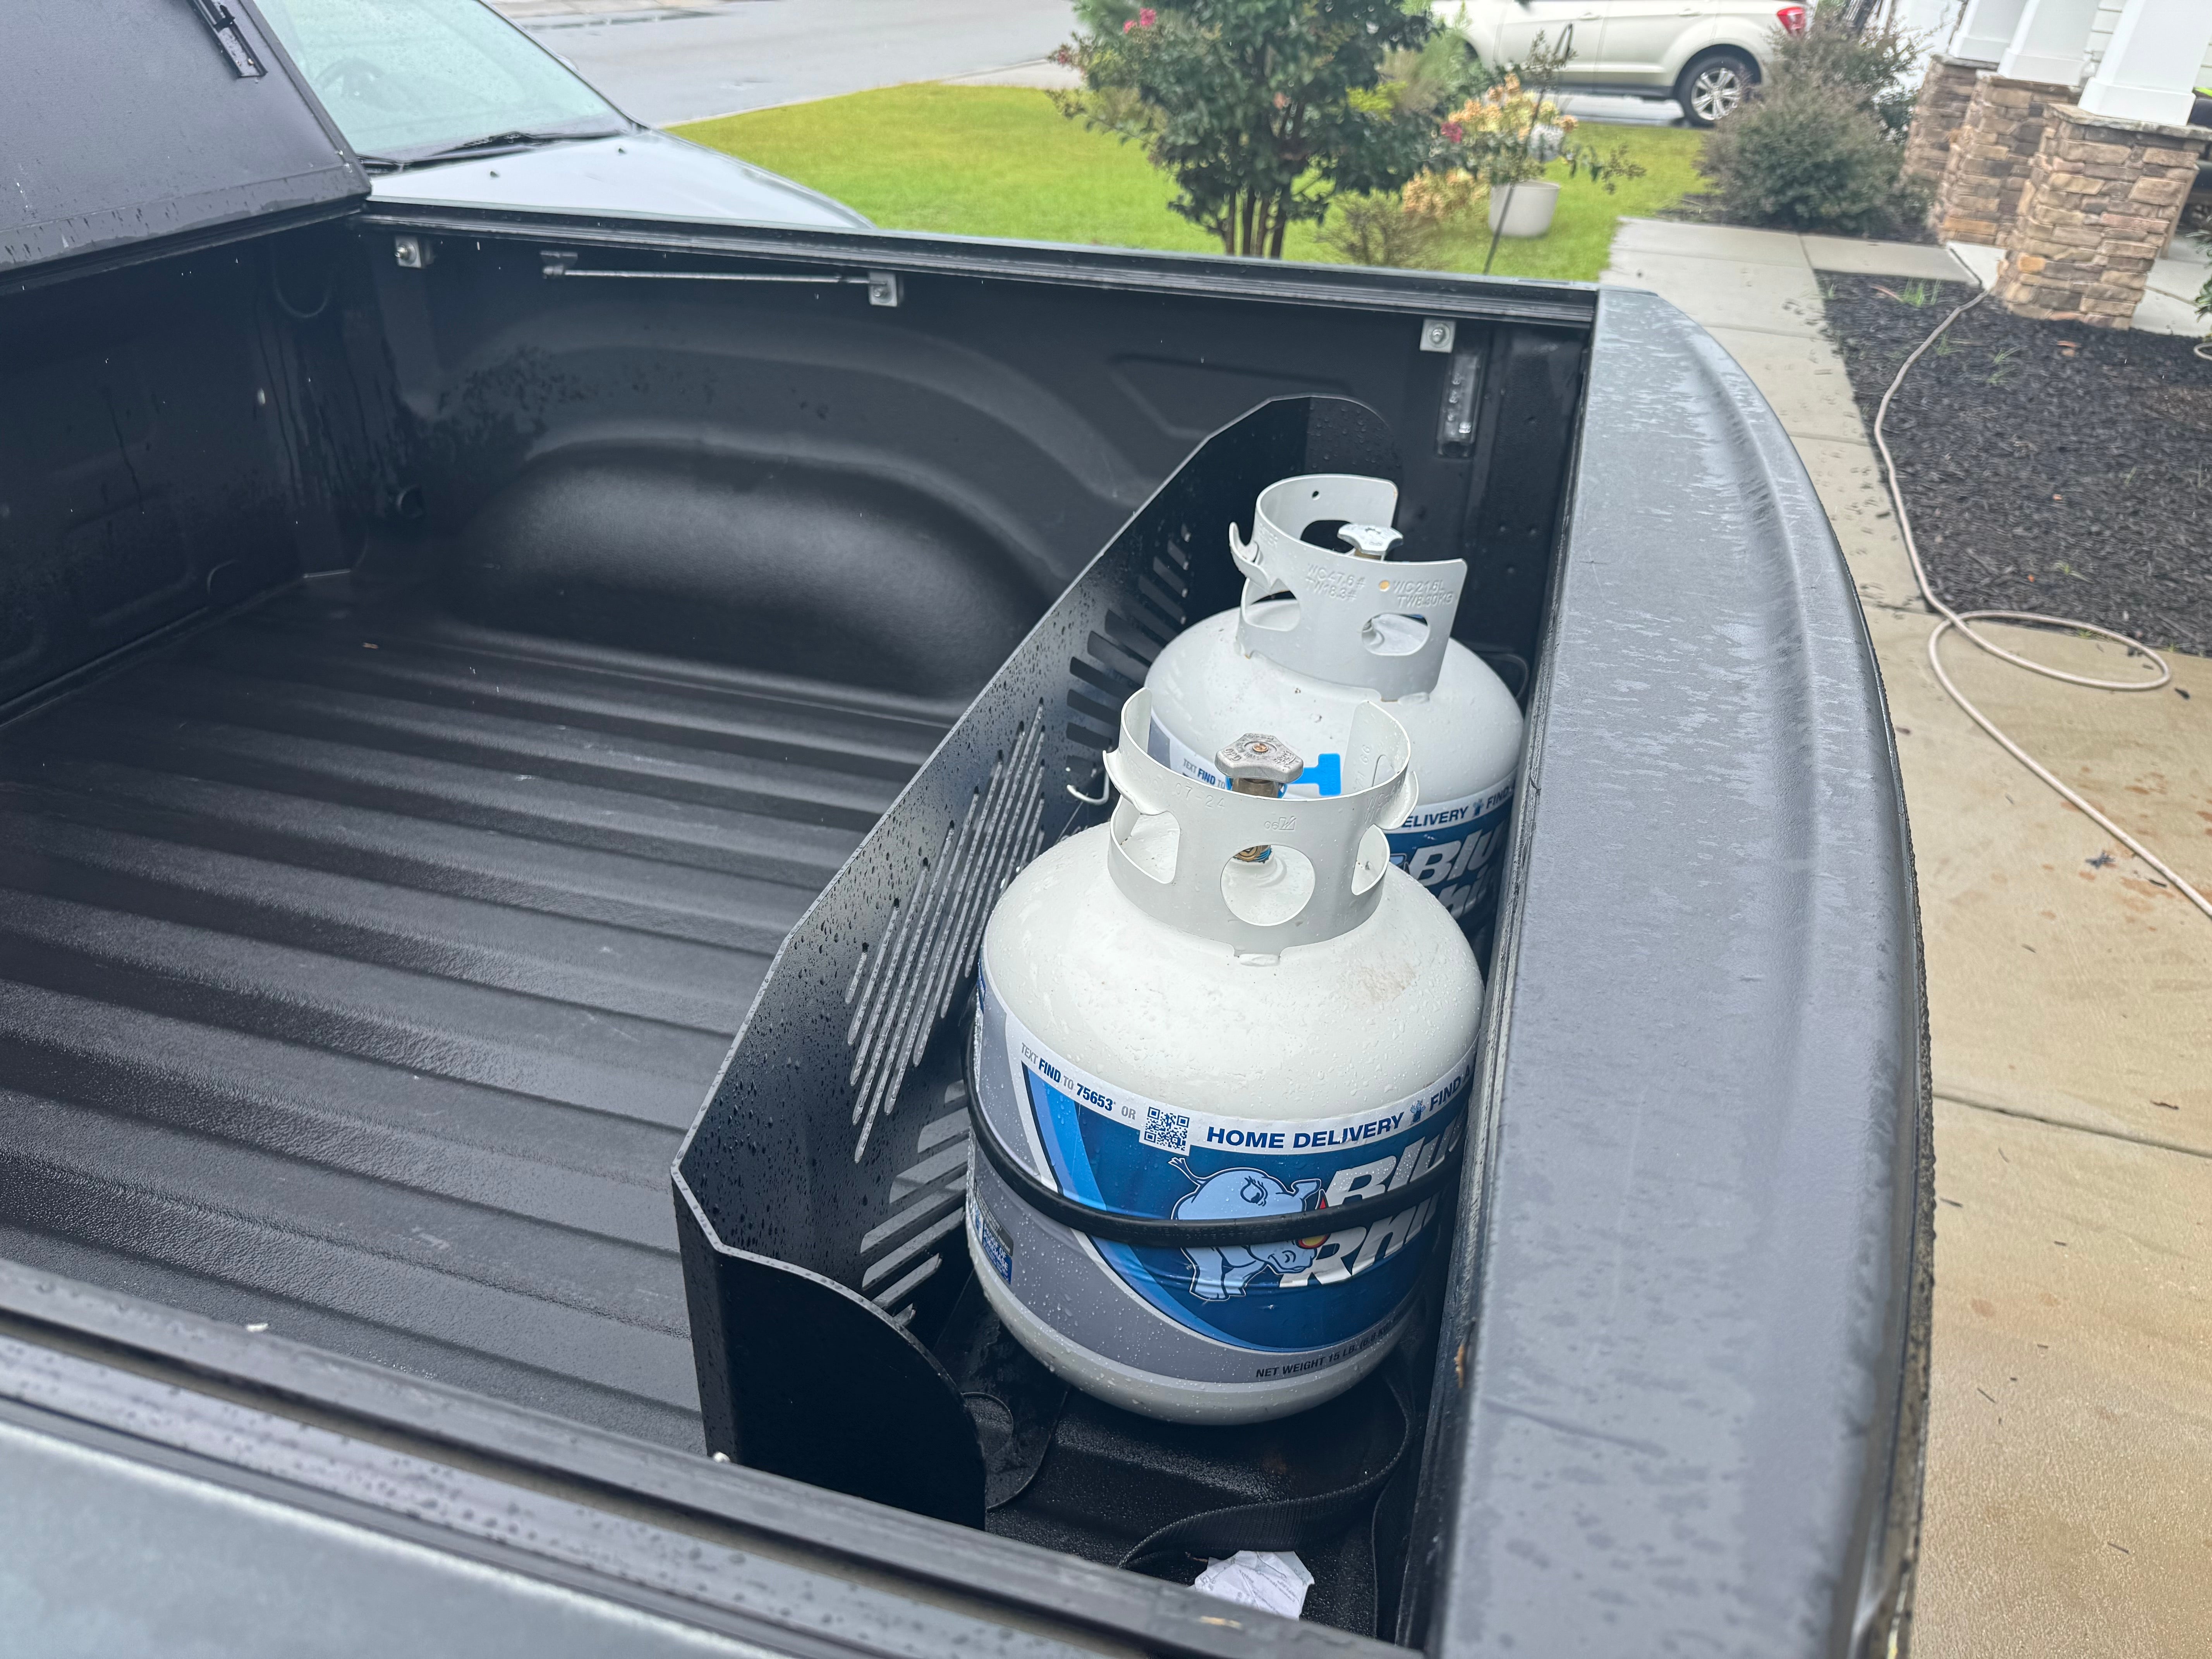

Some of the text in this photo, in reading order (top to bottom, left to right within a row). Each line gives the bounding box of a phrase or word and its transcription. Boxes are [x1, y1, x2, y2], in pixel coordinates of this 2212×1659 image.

[1224, 748, 1242, 761] OPD
[1183, 758, 1225, 789] TEXT FIND TO
[1402, 807, 1469, 828] ELIVERY
[1408, 821, 1506, 886] Blu
[1021, 1042, 1039, 1064] TEXT
[1038, 1057, 1061, 1083] FIND
[1063, 1075, 1074, 1091] TO
[1121, 1106, 1137, 1120] OR
[1206, 1126, 1285, 1149] HOME
[1293, 1111, 1404, 1149] DELIVERY
[1429, 1075, 1462, 1112] FIND
[999, 1246, 1007, 1258] OF
[1256, 1367, 1279, 1378] NET
[1282, 1356, 1326, 1375] WEIGHT
[1329, 1351, 1340, 1362] 15
[1342, 1343, 1357, 1357] LB.
